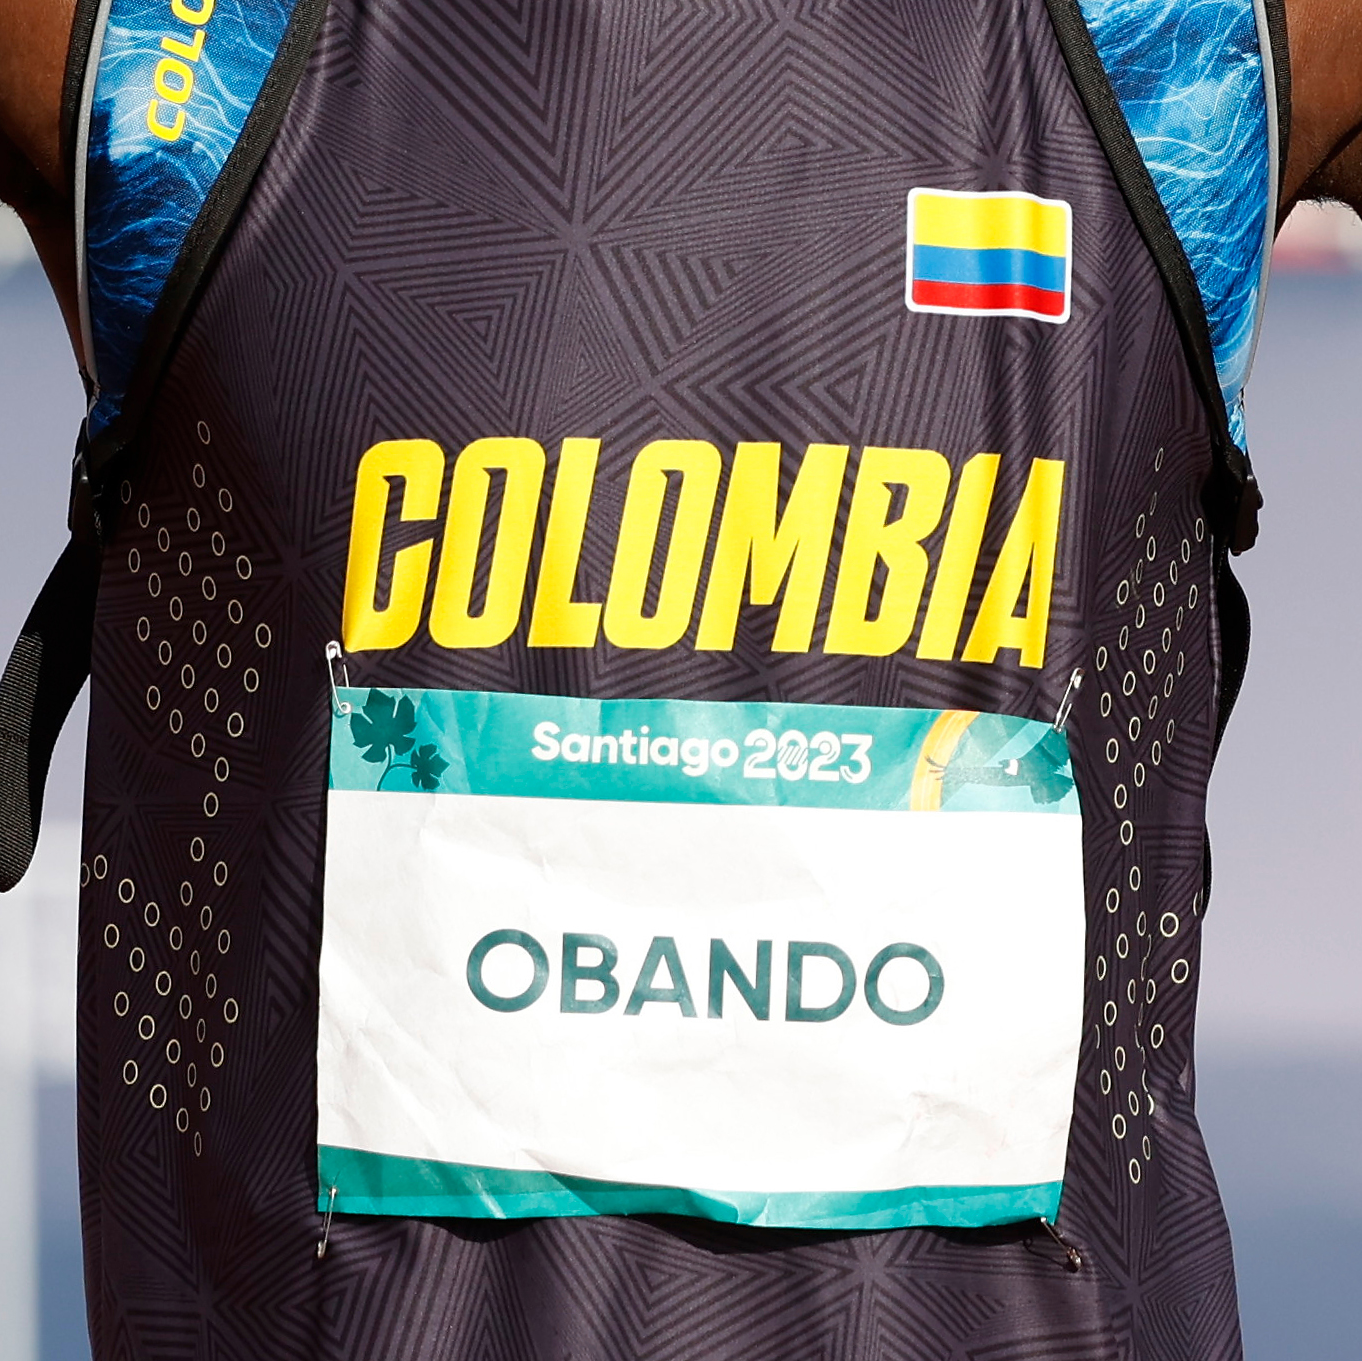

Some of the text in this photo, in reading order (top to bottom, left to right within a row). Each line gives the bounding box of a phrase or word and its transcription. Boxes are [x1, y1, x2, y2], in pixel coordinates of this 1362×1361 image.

[341, 437, 1066, 669] COLOMBIA
[531, 721, 874, 784] Santiago 2023
[465, 928, 945, 1026] OBANDO
